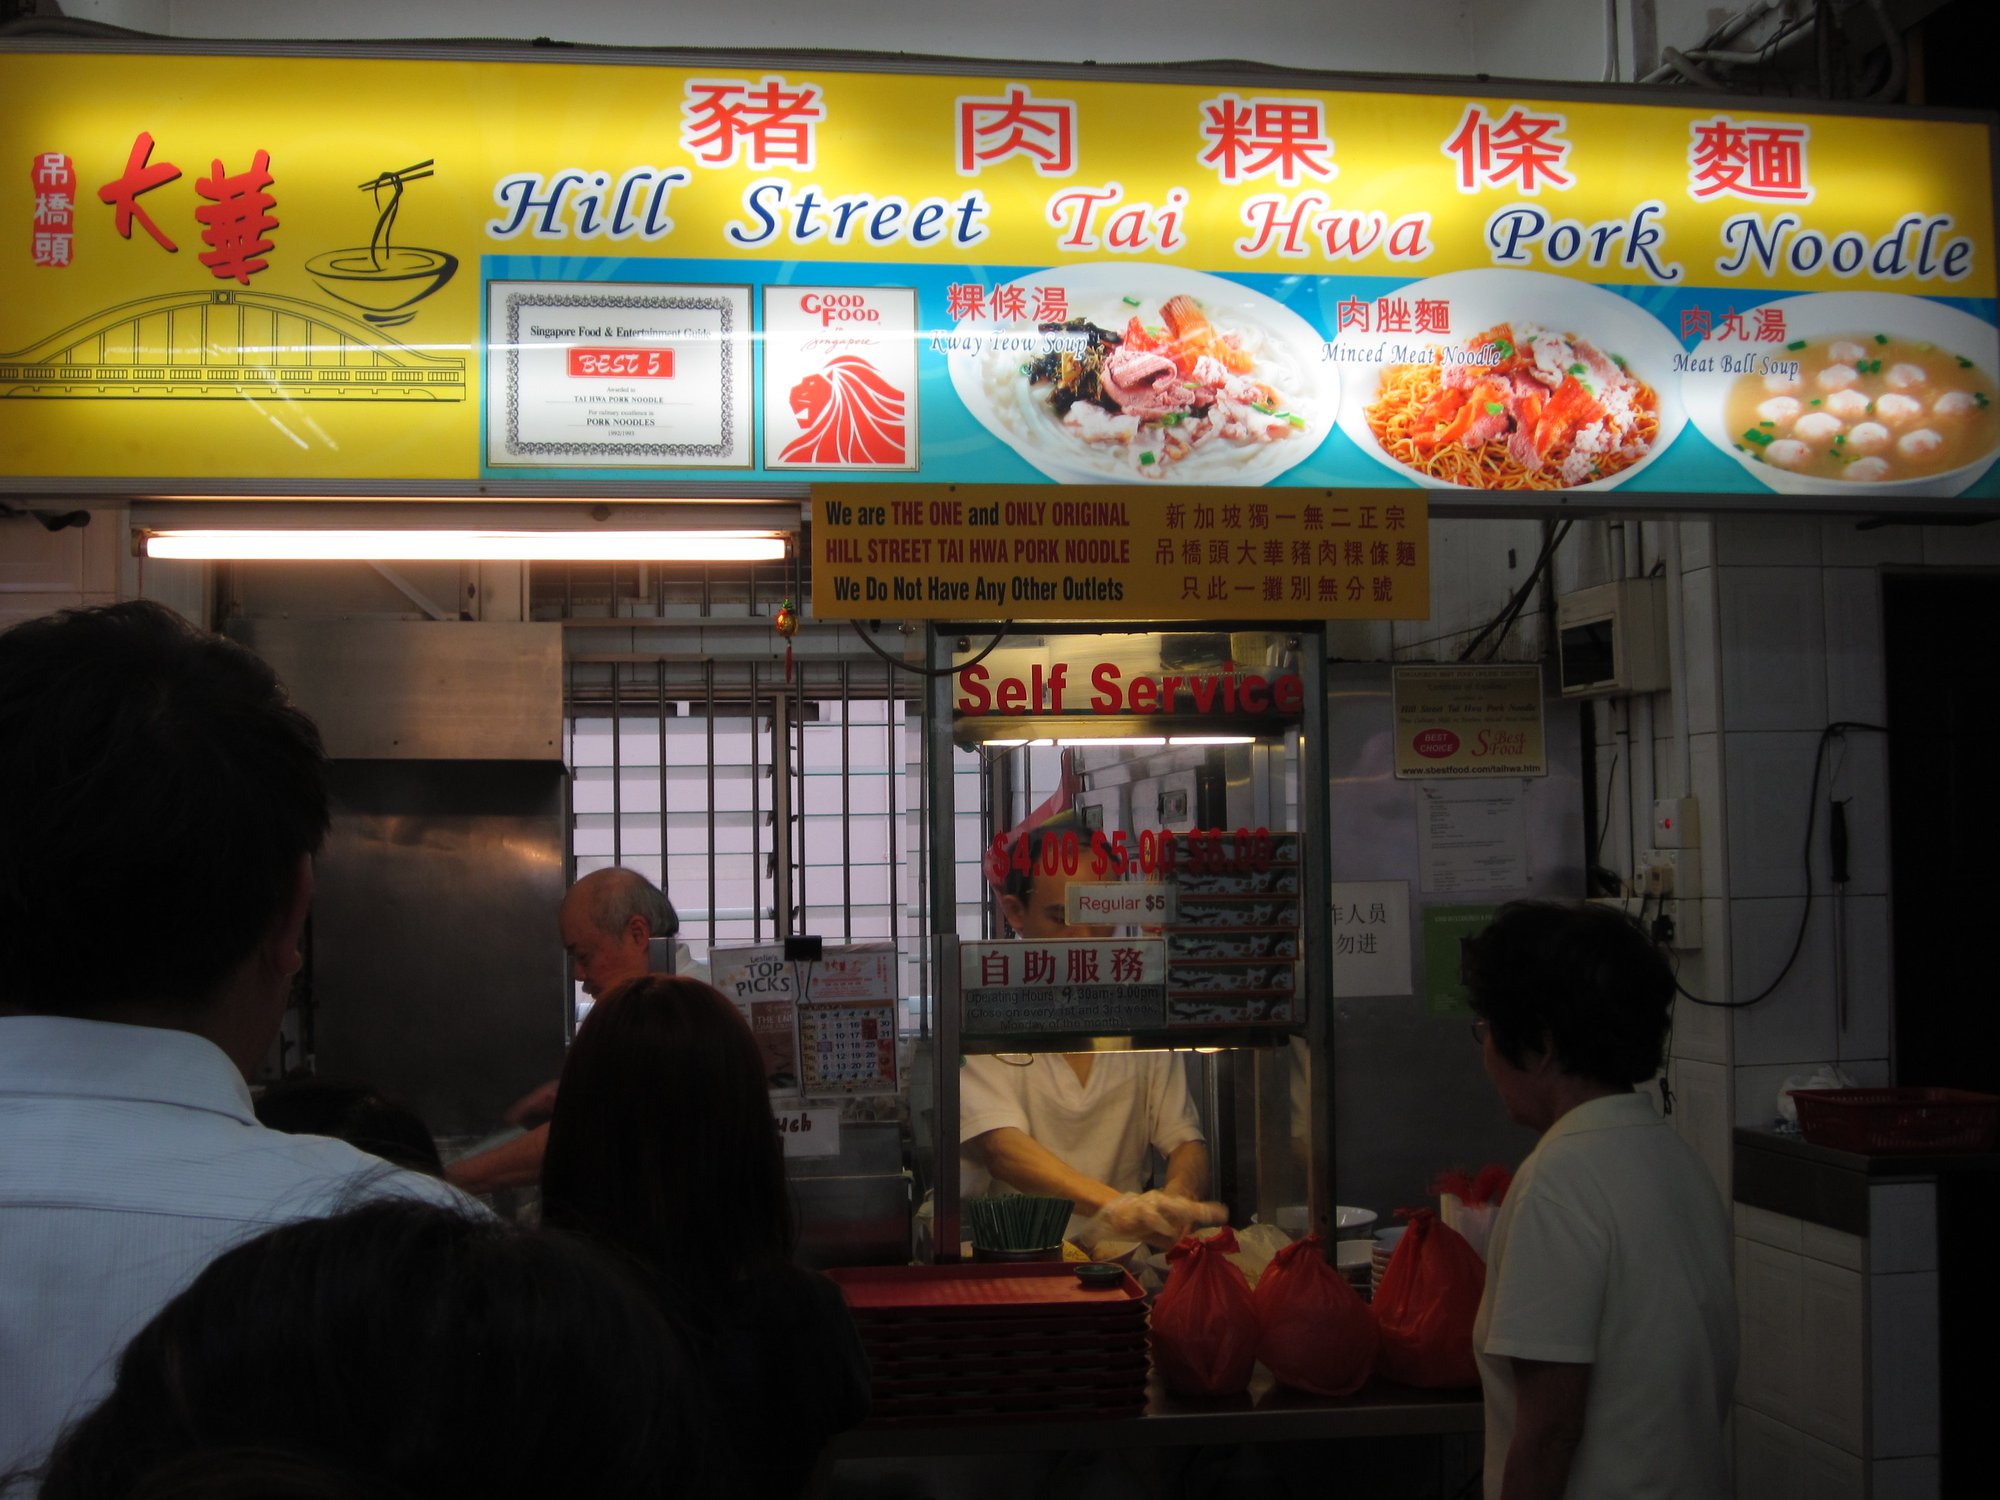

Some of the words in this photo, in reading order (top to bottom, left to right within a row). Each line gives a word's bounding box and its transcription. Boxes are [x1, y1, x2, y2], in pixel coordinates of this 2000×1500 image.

[34, 153, 73, 266] 吊橋頭
[97, 131, 279, 285] 大華
[492, 172, 685, 235] Hill
[731, 184, 983, 243] Street
[1052, 187, 1185, 247] Tai
[1240, 197, 1431, 257] Hwa
[1489, 205, 1678, 280] Pork
[1719, 217, 1971, 277] Noodle
[801, 293, 865, 314] GOOD
[947, 284, 1069, 322] 粿條湯
[1337, 296, 1451, 334] 肉脞麵
[822, 308, 879, 327] FOOD
[1681, 304, 1787, 343] 肉丸湯
[530, 325, 576, 339] Singapore
[578, 326, 601, 337] Food
[604, 327, 613, 337] &
[616, 327, 681, 339] Entertainment
[683, 328, 712, 339] Guide
[930, 330, 982, 356] Kway
[990, 330, 1036, 351] Teow
[1042, 333, 1088, 359] Soup
[578, 354, 639, 374] BEST
[648, 353, 661, 374] 5
[1321, 341, 1387, 363] Minced
[1391, 343, 1434, 365] Meat
[1441, 345, 1501, 366] Noodle
[1673, 353, 1714, 373] Meat
[1721, 353, 1757, 374] Ball
[1760, 356, 1799, 380] Soup
[574, 395, 588, 403] TAI
[608, 396, 629, 404] PORK
[631, 396, 664, 404] NOODLE
[586, 418, 611, 426] PORK
[613, 418, 656, 427] NOODLES
[825, 501, 852, 526] We
[857, 506, 886, 526] are
[891, 501, 924, 526] THE
[929, 501, 963, 526] ONE
[968, 501, 999, 526] and
[1005, 501, 1047, 526] ONLY
[1052, 501, 1131, 526] ORIGINAL
[1166, 503, 1406, 530] 新加坡獨一無二正宗
[825, 538, 863, 563] HILL
[868, 538, 932, 563] STREET
[938, 538, 965, 563] TAI
[969, 538, 1009, 563] HWA
[1014, 538, 1060, 563] PORK
[1065, 538, 1131, 564] NOODLE
[1155, 538, 1416, 567] 吊橋頭大華豬肉粿條麵
[834, 576, 861, 601] We
[866, 576, 888, 601] Do
[893, 576, 922, 601] Not
[928, 576, 969, 601] Have
[975, 576, 1006, 606] Any
[1011, 576, 1058, 601] Other
[1063, 576, 1124, 601] Outlets
[1181, 575, 1393, 602] 只此一攤別無分號
[958, 663, 1068, 716] Self
[1091, 659, 1304, 716] Service
[1420, 744, 1453, 753] CHOICE
[1424, 733, 1448, 742] BEST
[1489, 743, 1525, 756] Food
[1495, 731, 1526, 744] Best
[1402, 764, 1541, 775] www.sbestfood.com/taihwa.htm
[992, 830, 1079, 878] $4.00
[1091, 828, 1177, 876] $5.00
[1079, 895, 1140, 912] Regular
[1145, 894, 1165, 912] $5
[744, 962, 784, 978] TOP
[981, 948, 1143, 986] 自助服務
[736, 977, 791, 997] PICKS
[966, 987, 1018, 1006] Operating
[1005, 1008, 1020, 1018] on
[1078, 1005, 1099, 1016] and
[1102, 1004, 1121, 1015] 3rd
[999, 1019, 1046, 1032] Monday
[1062, 1018, 1082, 1029] the
